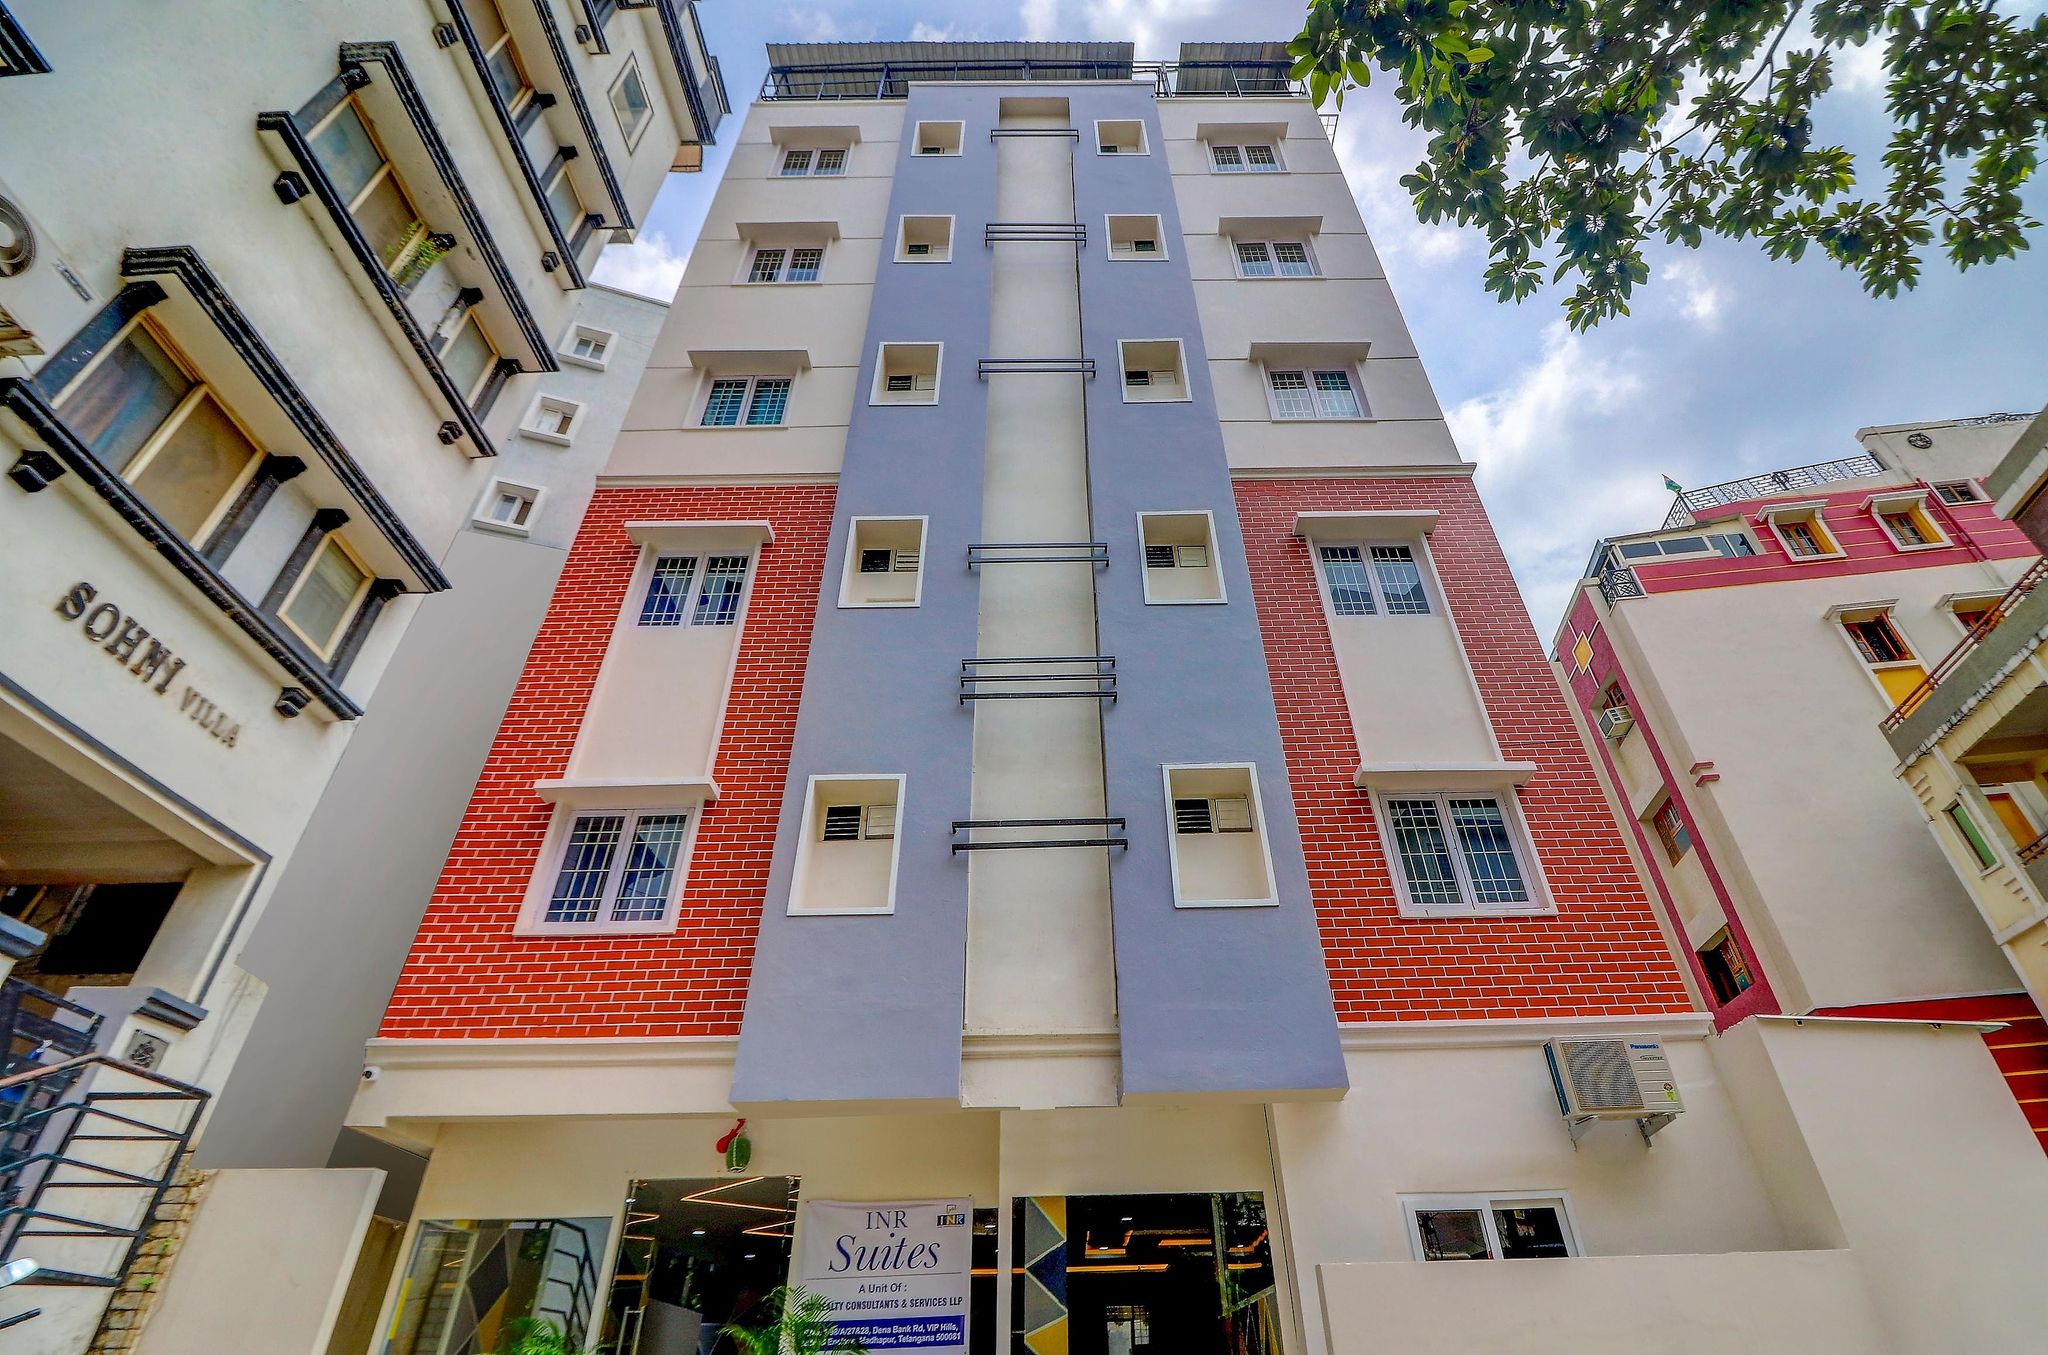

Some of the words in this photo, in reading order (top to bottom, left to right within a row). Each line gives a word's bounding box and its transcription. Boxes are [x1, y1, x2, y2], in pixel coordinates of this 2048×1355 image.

[55, 582, 187, 695] SOHNI
[179, 686, 241, 748] VILLA
[866, 1210, 908, 1230] INR
[937, 1214, 965, 1226] INR
[828, 1232, 941, 1272] Suites
[858, 1284, 866, 1294] A
[868, 1283, 888, 1294] Unit
[845, 1298, 899, 1311] CONSULTANTS
[901, 1299, 908, 1309] &
[909, 1297, 947, 1308] SERVICES
[949, 1296, 963, 1306] LLP
[872, 1325, 892, 1335] Dena
[893, 1324, 912, 1334] Bank
[912, 1324, 925, 1334] Rd,
[926, 1323, 940, 1332] VIP
[940, 1322, 959, 1332] Hills,
[898, 1334, 935, 1344] Telangana
